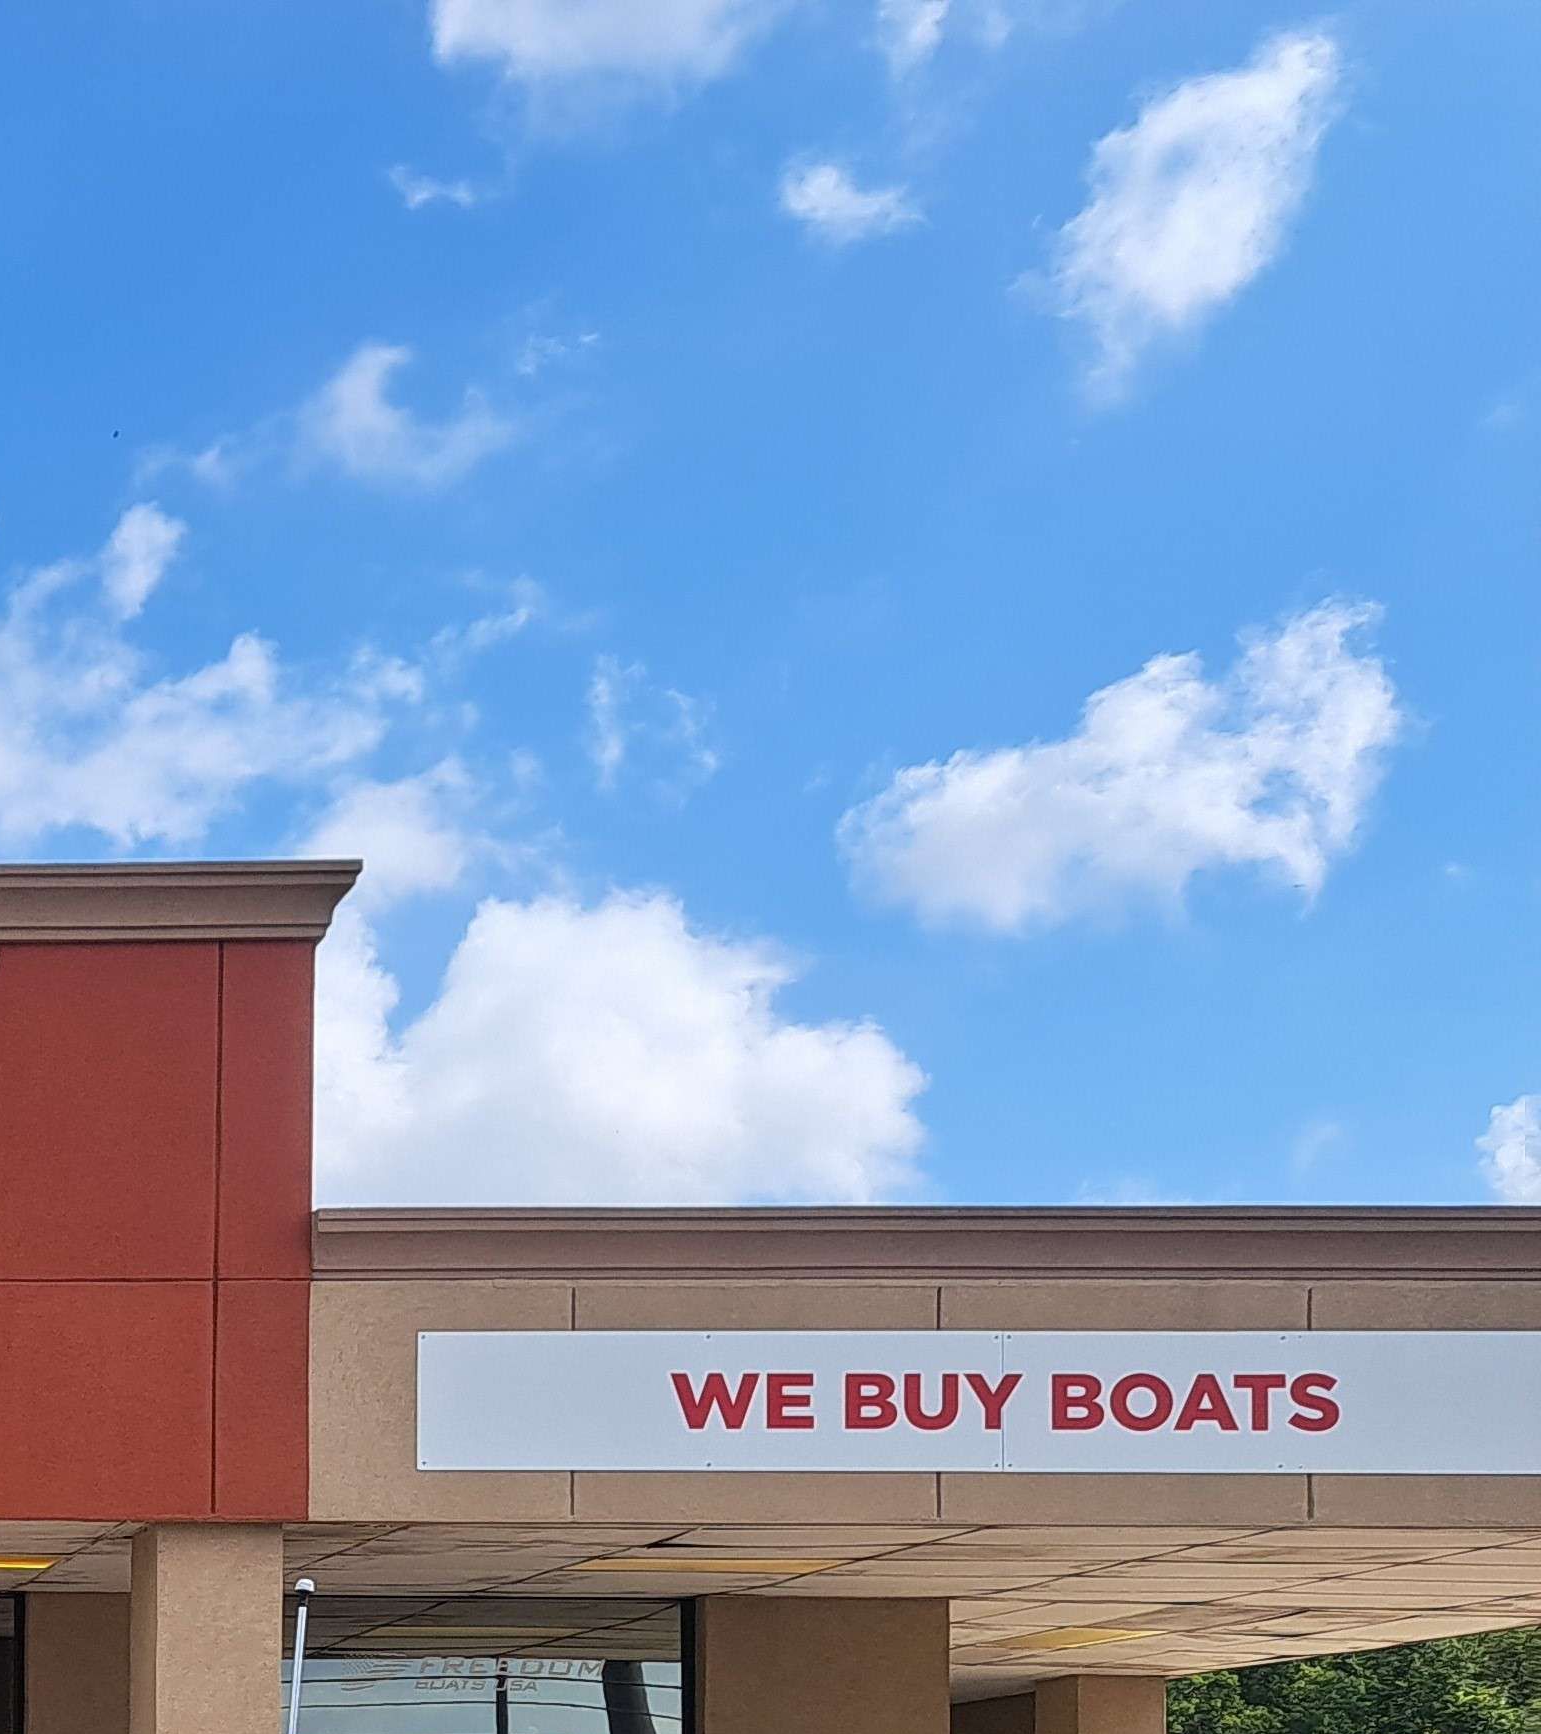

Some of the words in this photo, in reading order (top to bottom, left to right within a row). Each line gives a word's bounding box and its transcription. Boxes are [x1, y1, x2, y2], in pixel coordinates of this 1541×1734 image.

[670, 1372, 815, 1430] WE
[844, 1373, 1023, 1430] BUY
[1049, 1373, 1341, 1432] BOATS
[420, 1656, 604, 1677] FREEDOM
